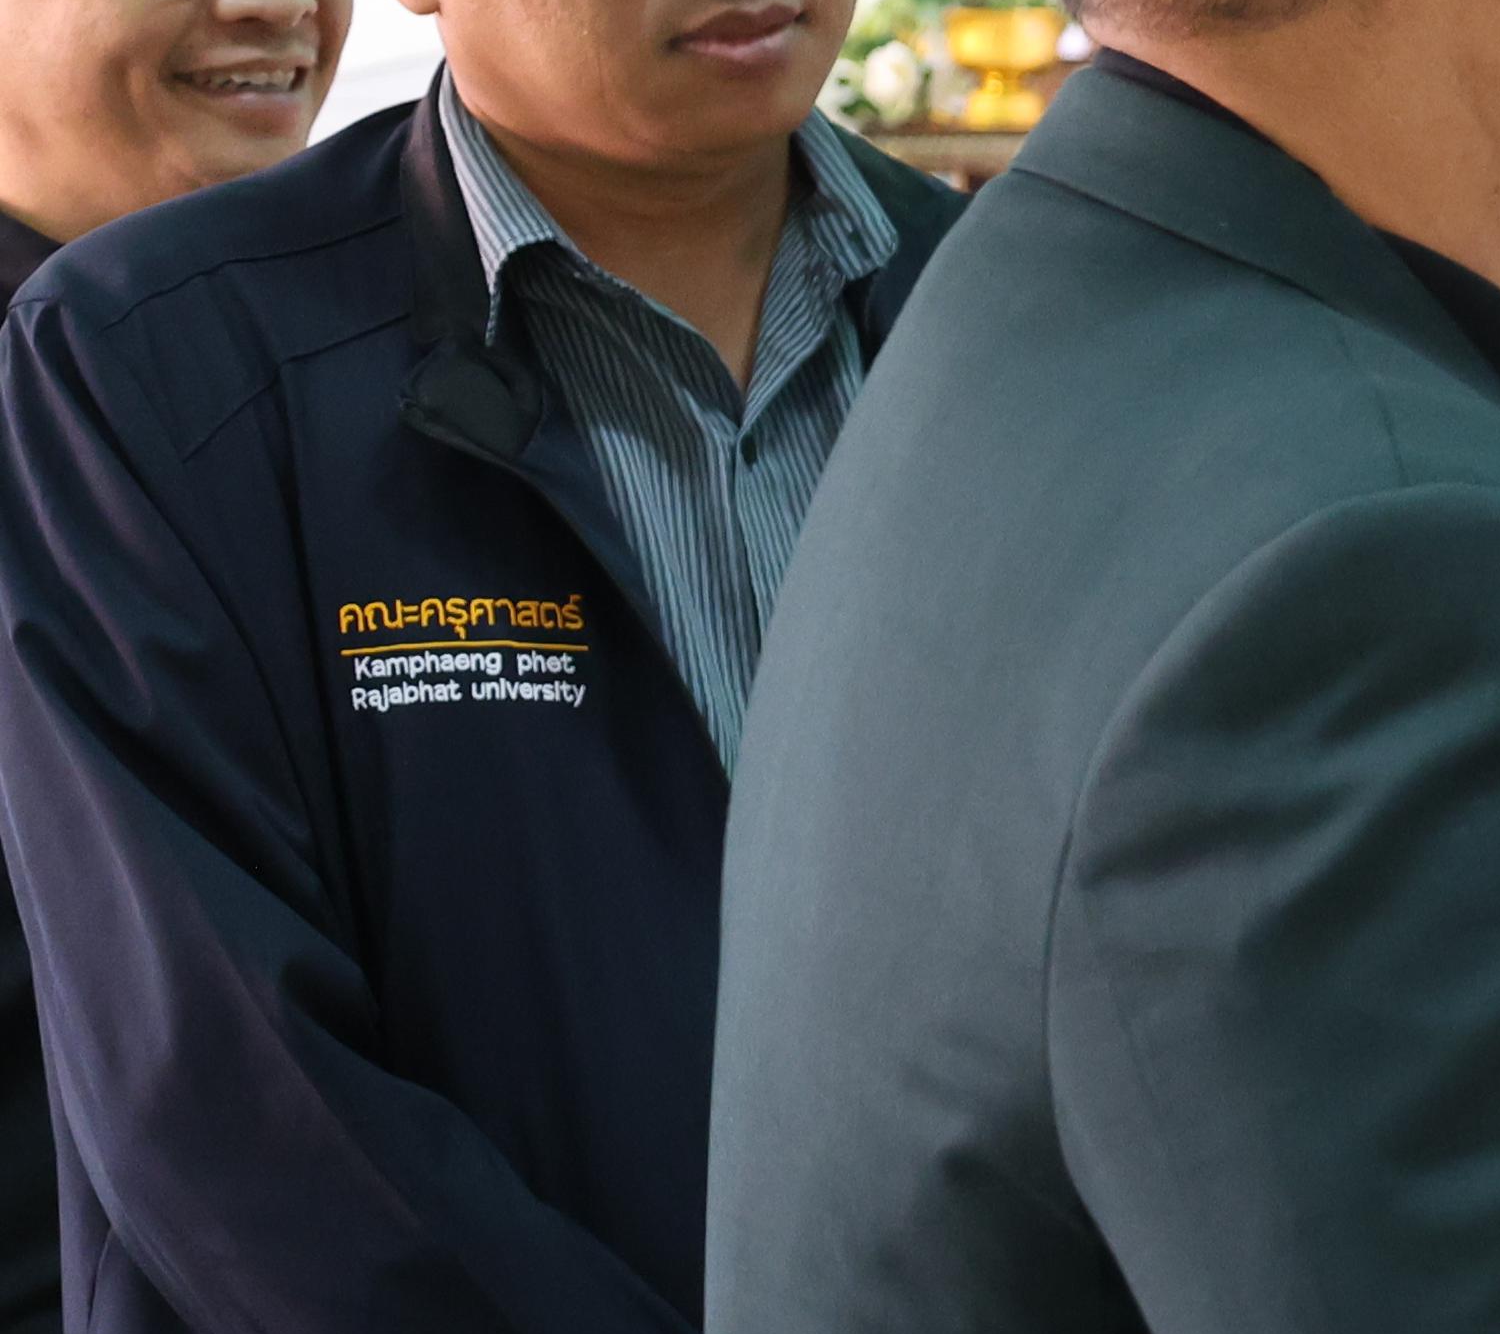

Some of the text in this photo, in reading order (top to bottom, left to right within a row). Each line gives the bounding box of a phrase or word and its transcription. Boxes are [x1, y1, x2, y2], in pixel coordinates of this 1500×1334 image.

[340, 594, 584, 639] คณะครุศาสตร์
[354, 651, 575, 680] Kamphaeng phet
[352, 678, 586, 712] Rajabhat university
